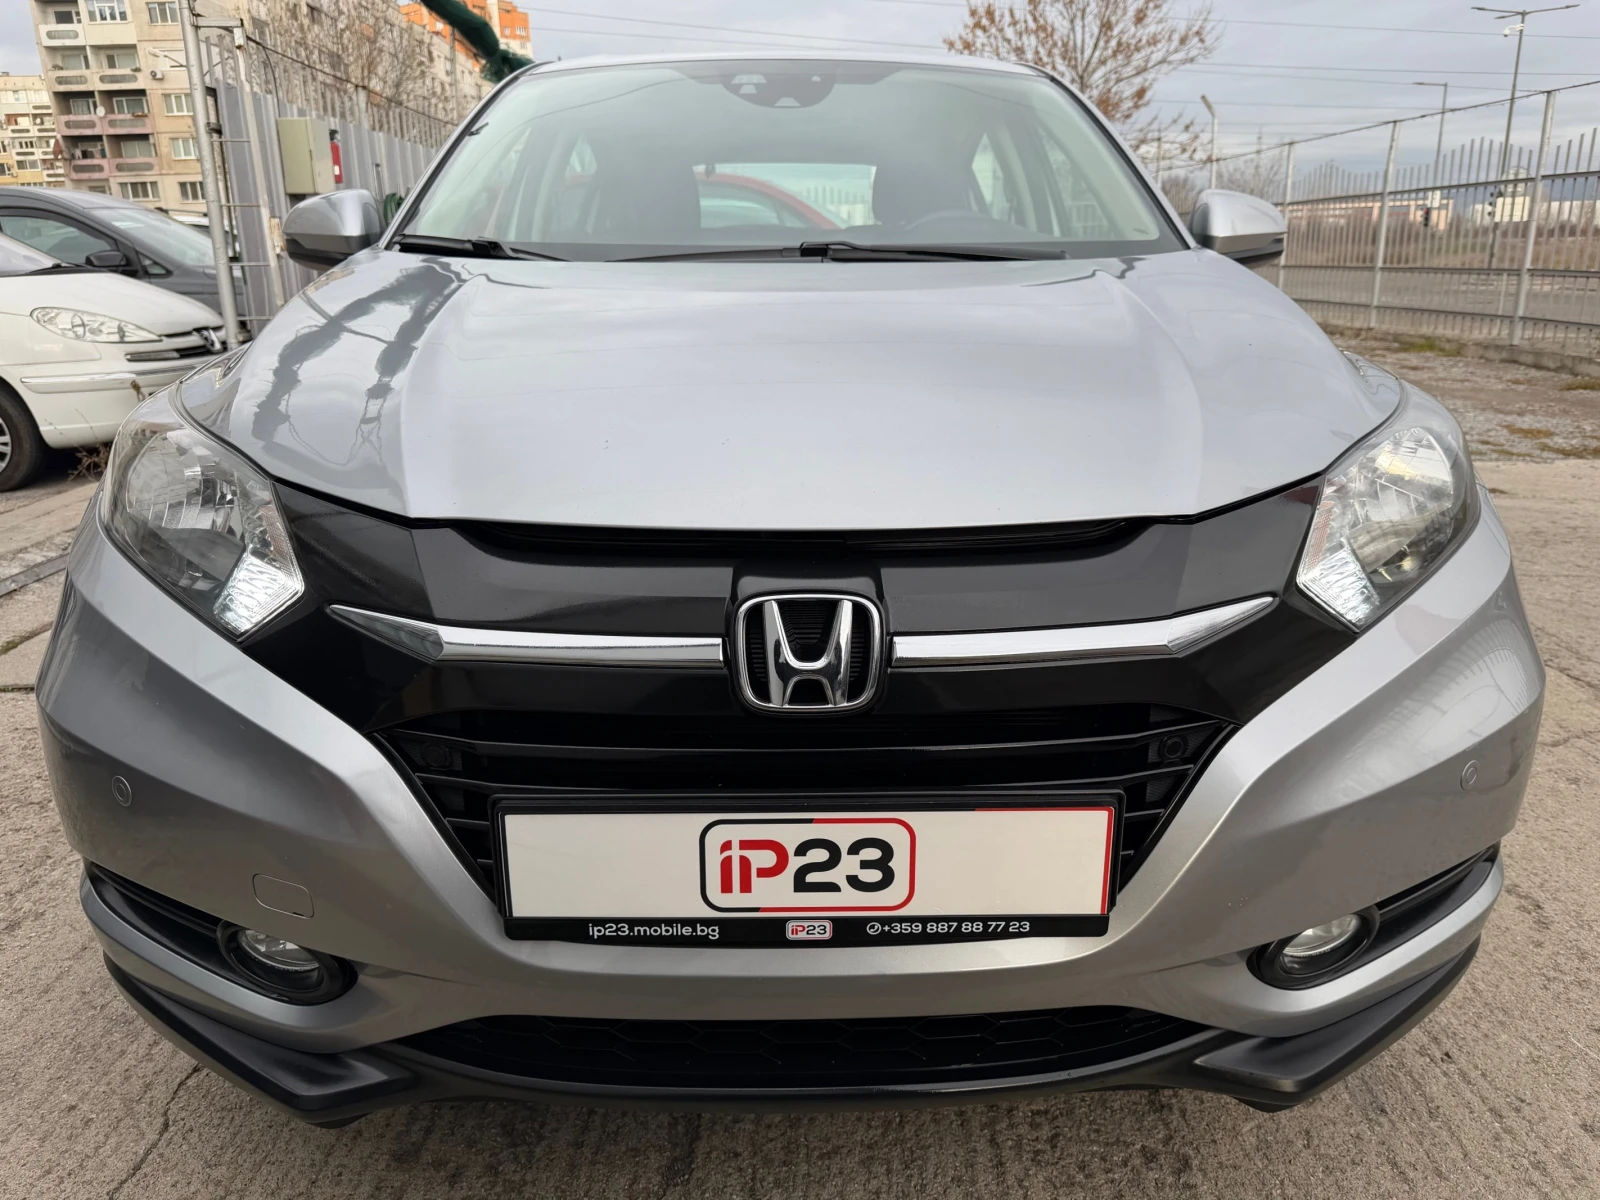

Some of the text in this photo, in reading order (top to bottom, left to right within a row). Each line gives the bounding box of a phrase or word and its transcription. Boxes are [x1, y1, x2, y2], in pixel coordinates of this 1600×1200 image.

[588, 923, 720, 940] ip23.mobile.bg
[882, 921, 1030, 934] +359 887 88 77 23
